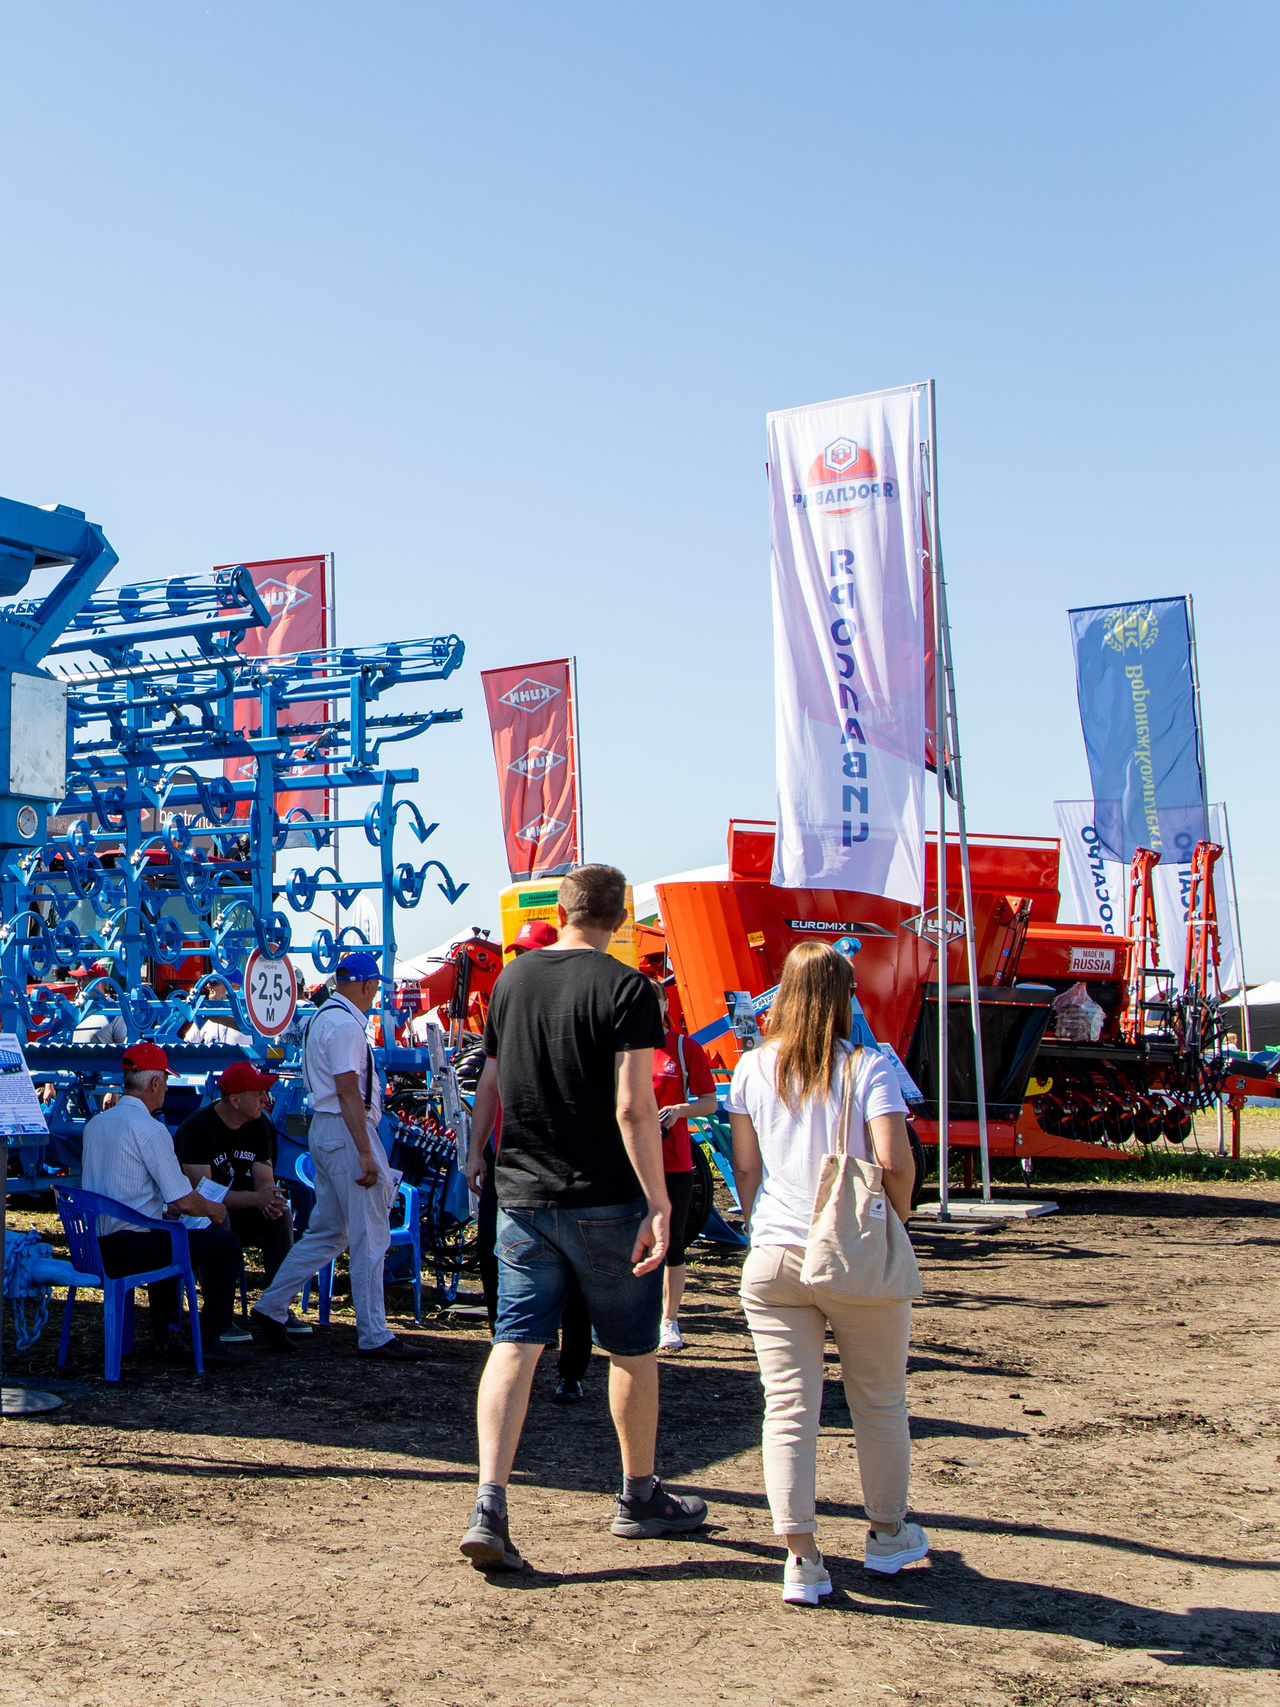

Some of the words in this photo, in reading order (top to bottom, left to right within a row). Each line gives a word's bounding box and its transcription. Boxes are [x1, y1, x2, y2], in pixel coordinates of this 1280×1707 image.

[791, 920, 847, 931] EUROMIX
[1082, 950, 1098, 958] MADE
[1098, 951, 1105, 959] IN
[1072, 958, 1111, 971] RUSSIA
[258, 971, 284, 1006] 2,5
